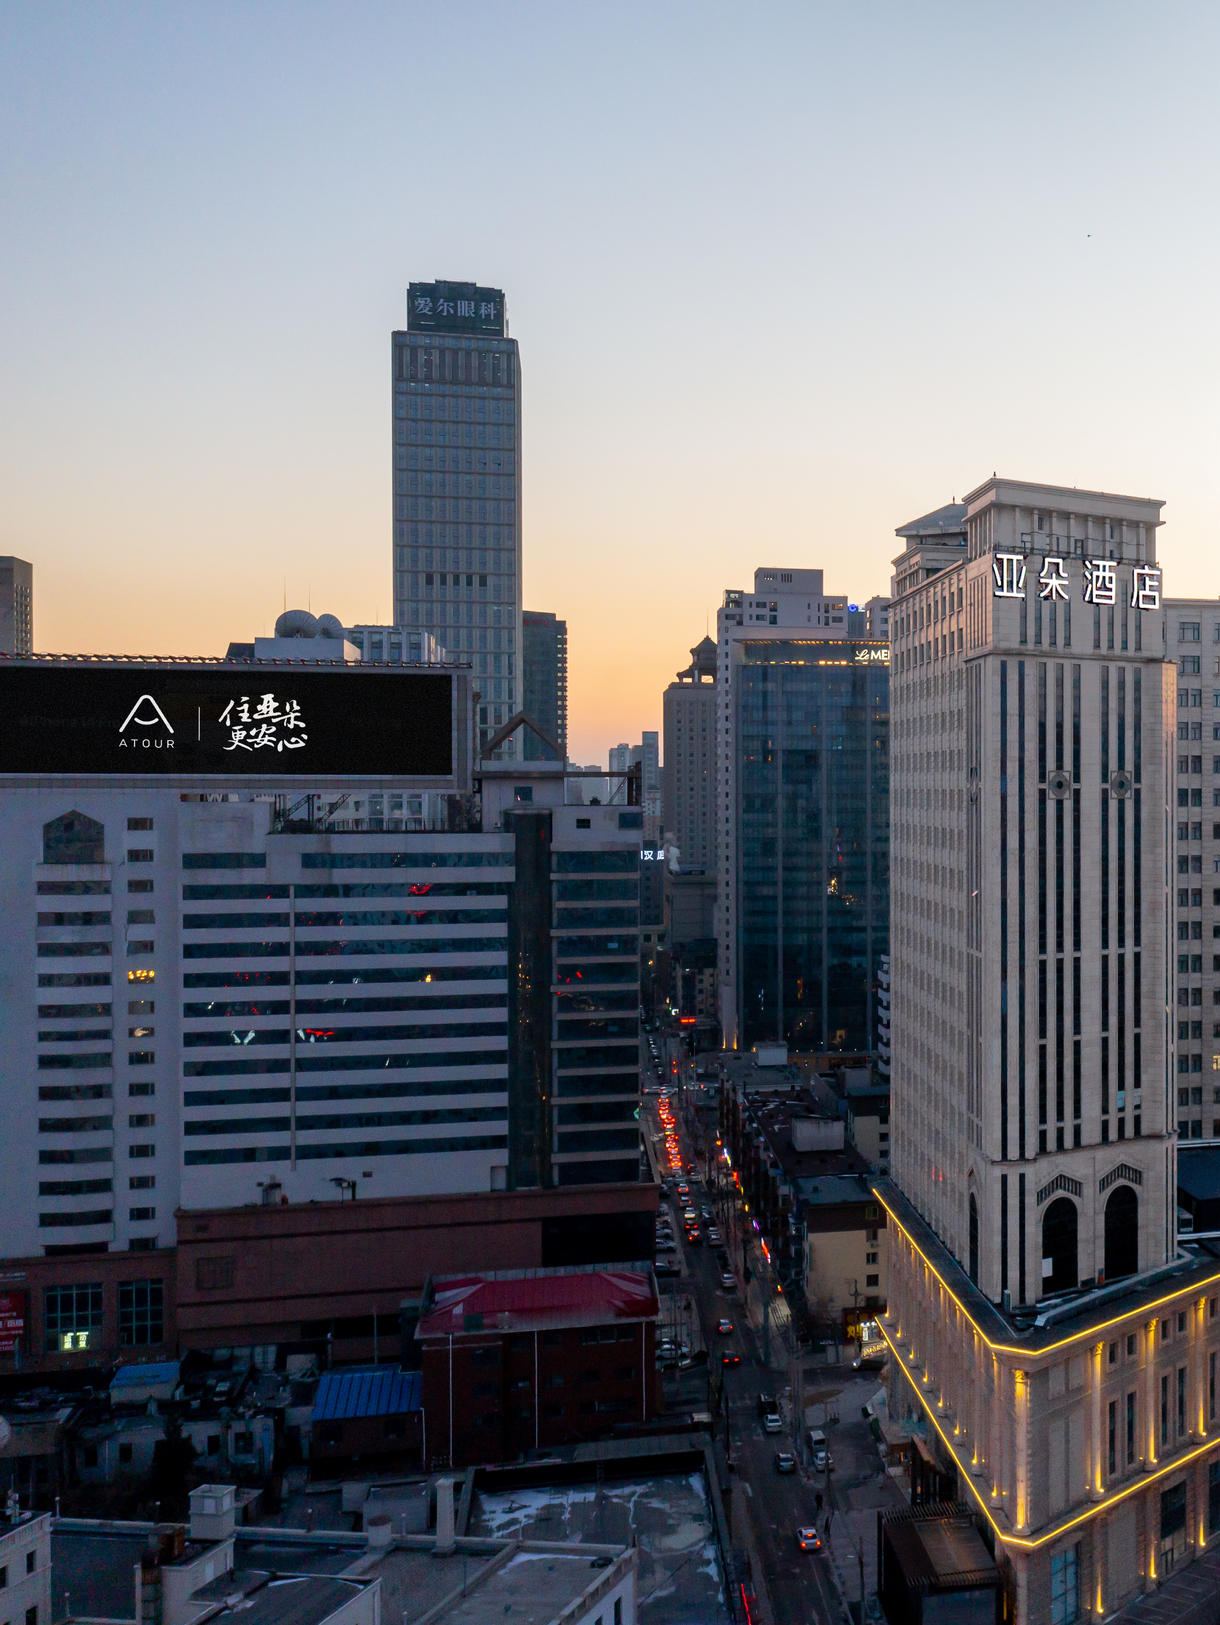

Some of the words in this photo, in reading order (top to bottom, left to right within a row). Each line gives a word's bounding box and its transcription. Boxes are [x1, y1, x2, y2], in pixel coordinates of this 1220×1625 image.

[415, 297, 497, 320] 爱尔眼科
[993, 553, 1161, 610] 亚朵酒店
[870, 649, 890, 660] ME
[118, 738, 175, 749] ATOUR
[222, 723, 308, 753] 更安心
